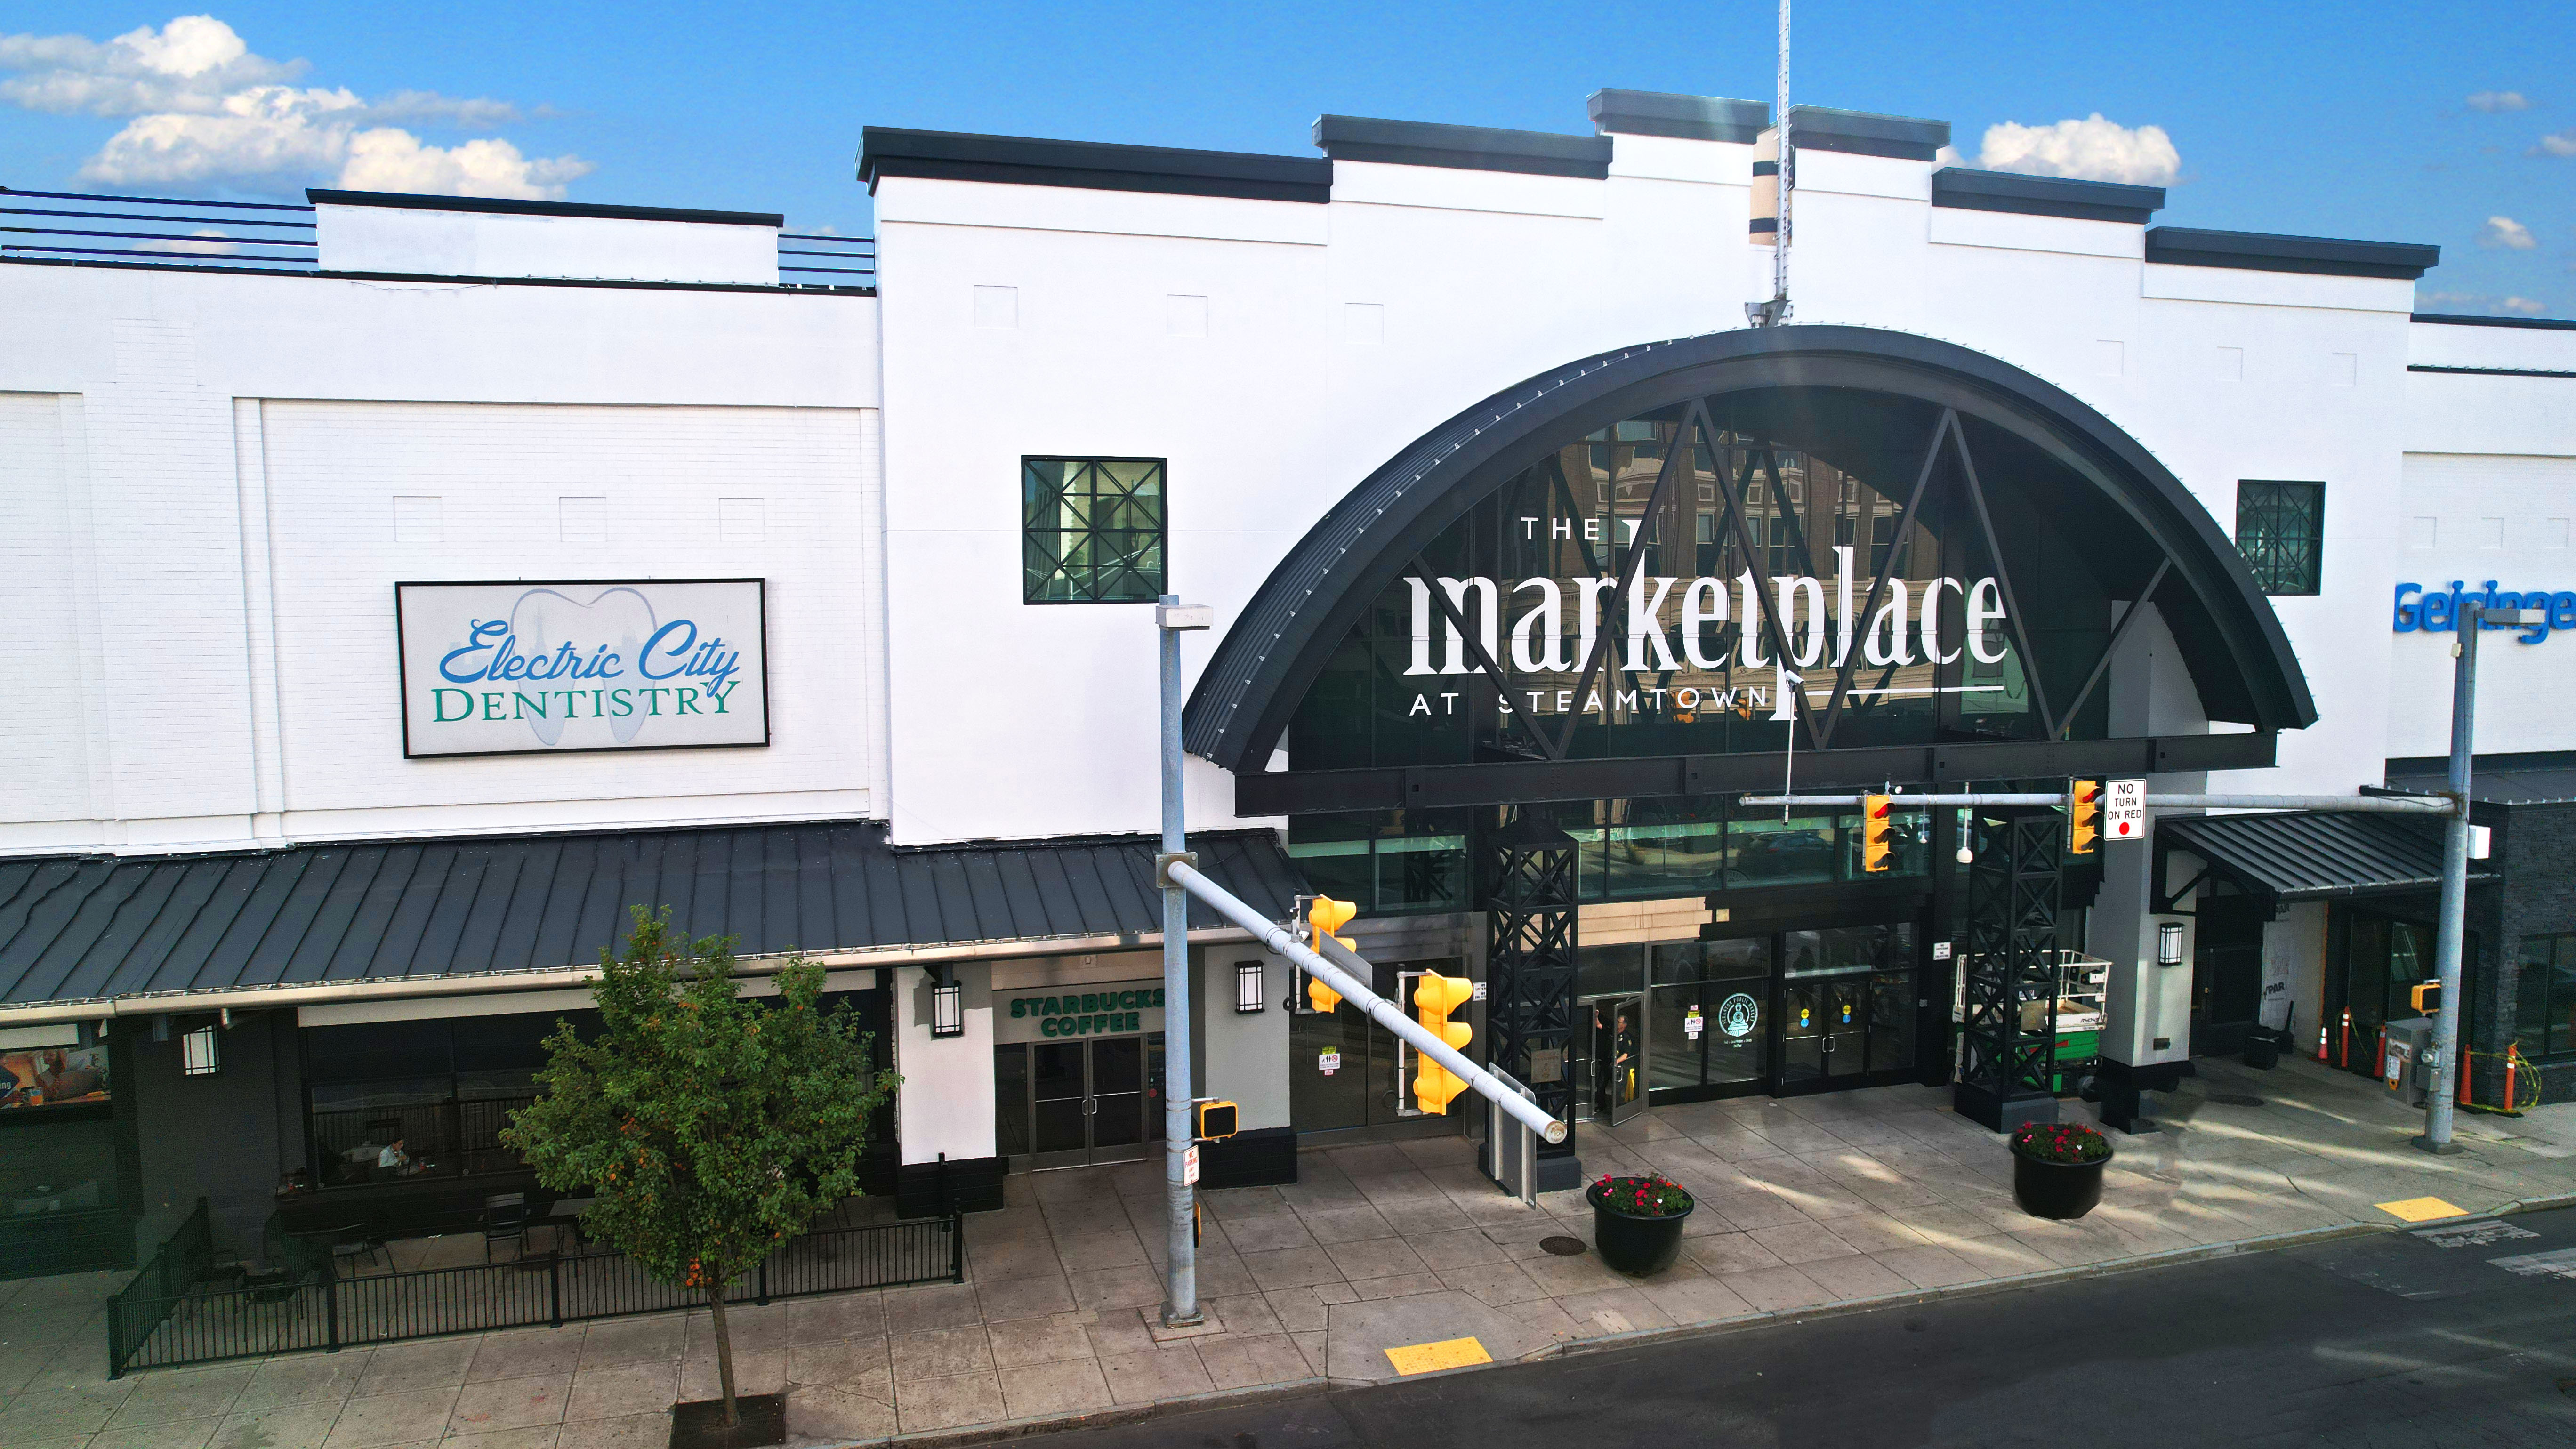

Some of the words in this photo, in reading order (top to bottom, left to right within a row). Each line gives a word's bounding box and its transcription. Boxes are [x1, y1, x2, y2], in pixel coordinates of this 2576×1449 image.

[1521, 517, 1599, 540] THE
[1403, 519, 2008, 721] marketplace
[439, 619, 625, 684] Electric
[639, 619, 740, 698] City
[431, 681, 741, 722] DENTISTRY
[1409, 693, 1459, 716] AT
[1498, 686, 1765, 713] STEAMTOWN
[2118, 783, 2133, 794] NO
[2114, 797, 2137, 807] TURN
[2108, 811, 2120, 820] ON
[2125, 809, 2141, 819] RED
[1010, 988, 1165, 1018] STARBUCKS
[1041, 1012, 1140, 1037] COFFEE
[1185, 1156, 1198, 1168] PARKING
[1188, 1151, 1194, 1159] NO
